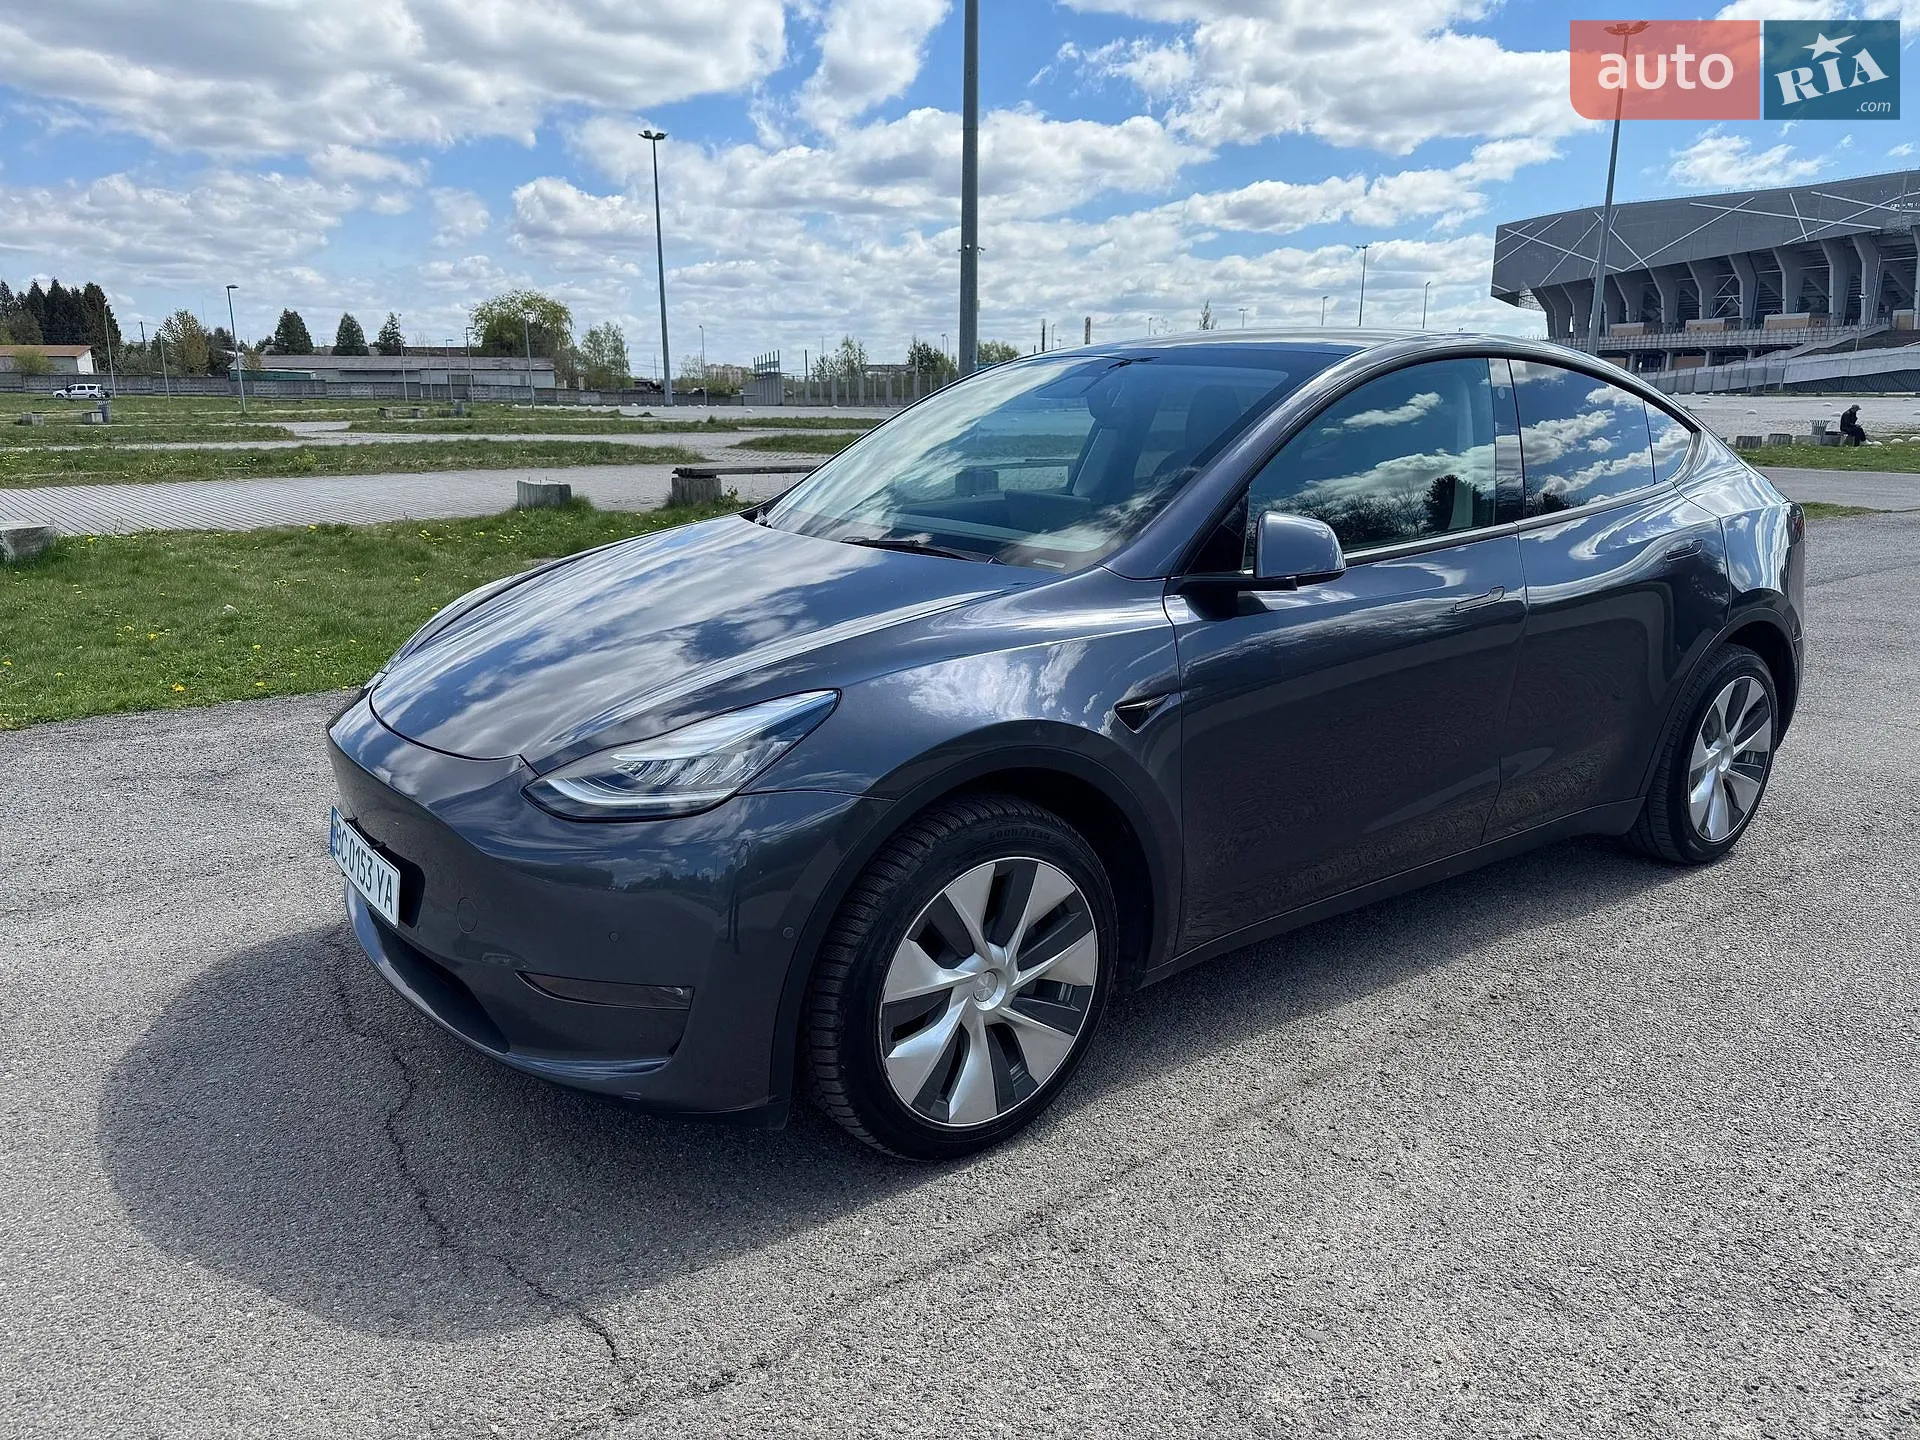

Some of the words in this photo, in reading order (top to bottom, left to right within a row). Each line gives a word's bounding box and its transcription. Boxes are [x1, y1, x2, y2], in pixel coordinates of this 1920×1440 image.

[335, 820, 348, 864] BC
[348, 838, 373, 892] 0153
[376, 863, 393, 915] YA
